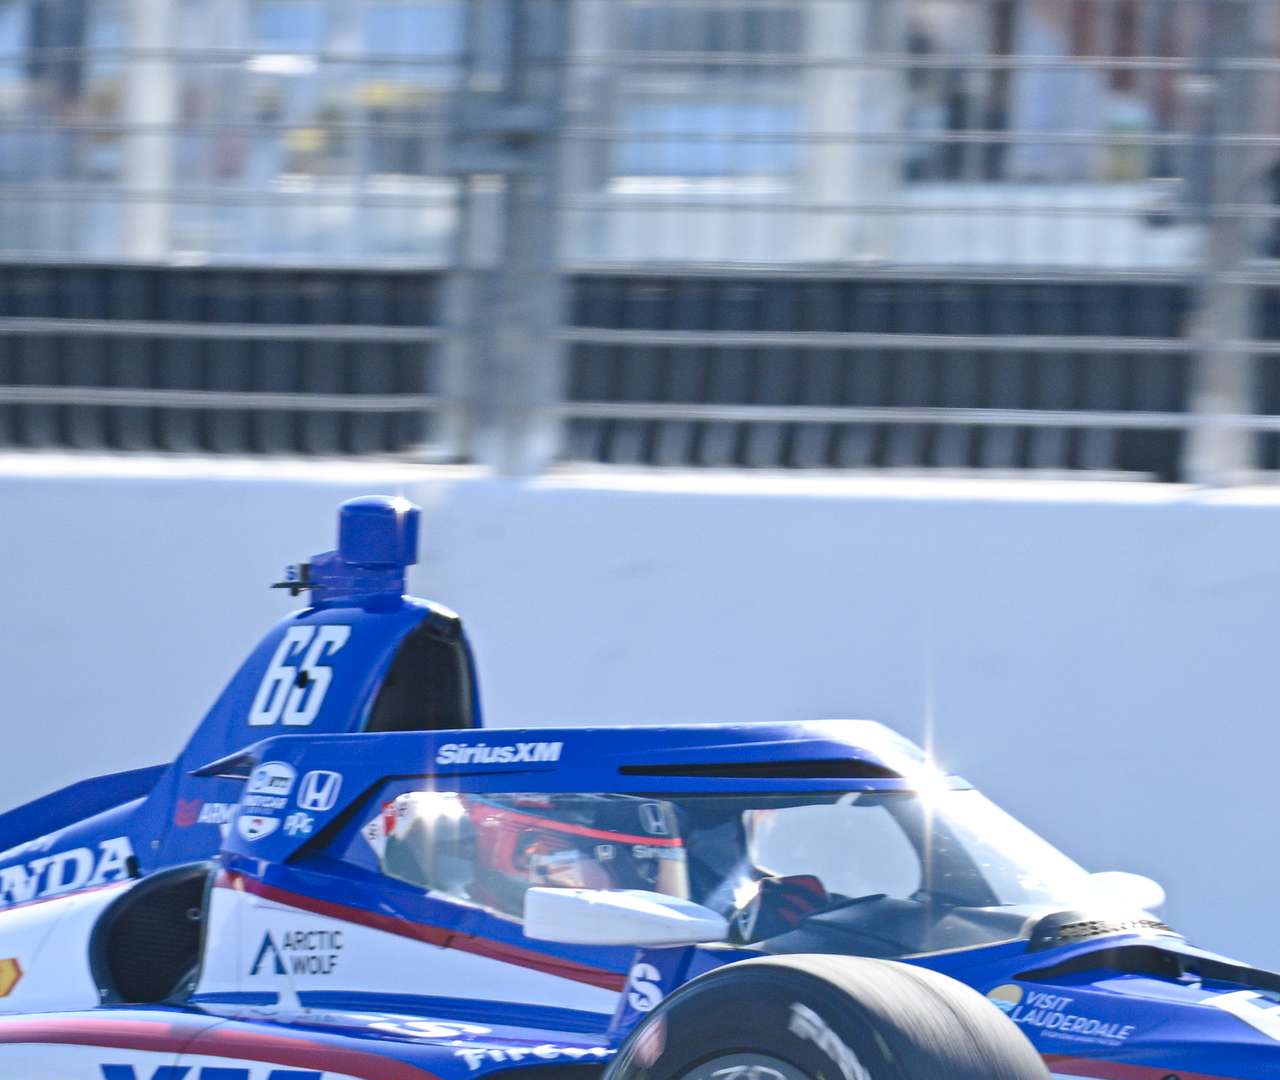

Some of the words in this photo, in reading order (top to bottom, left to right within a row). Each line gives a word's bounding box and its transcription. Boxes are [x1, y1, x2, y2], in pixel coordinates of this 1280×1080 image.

[435, 741, 563, 765] SiriusXM
[282, 930, 342, 951] ARCTIC
[289, 955, 338, 975] WOLF
[1025, 991, 1075, 1011] VISIT
[1010, 1005, 1136, 1041] LAUDERDALE
